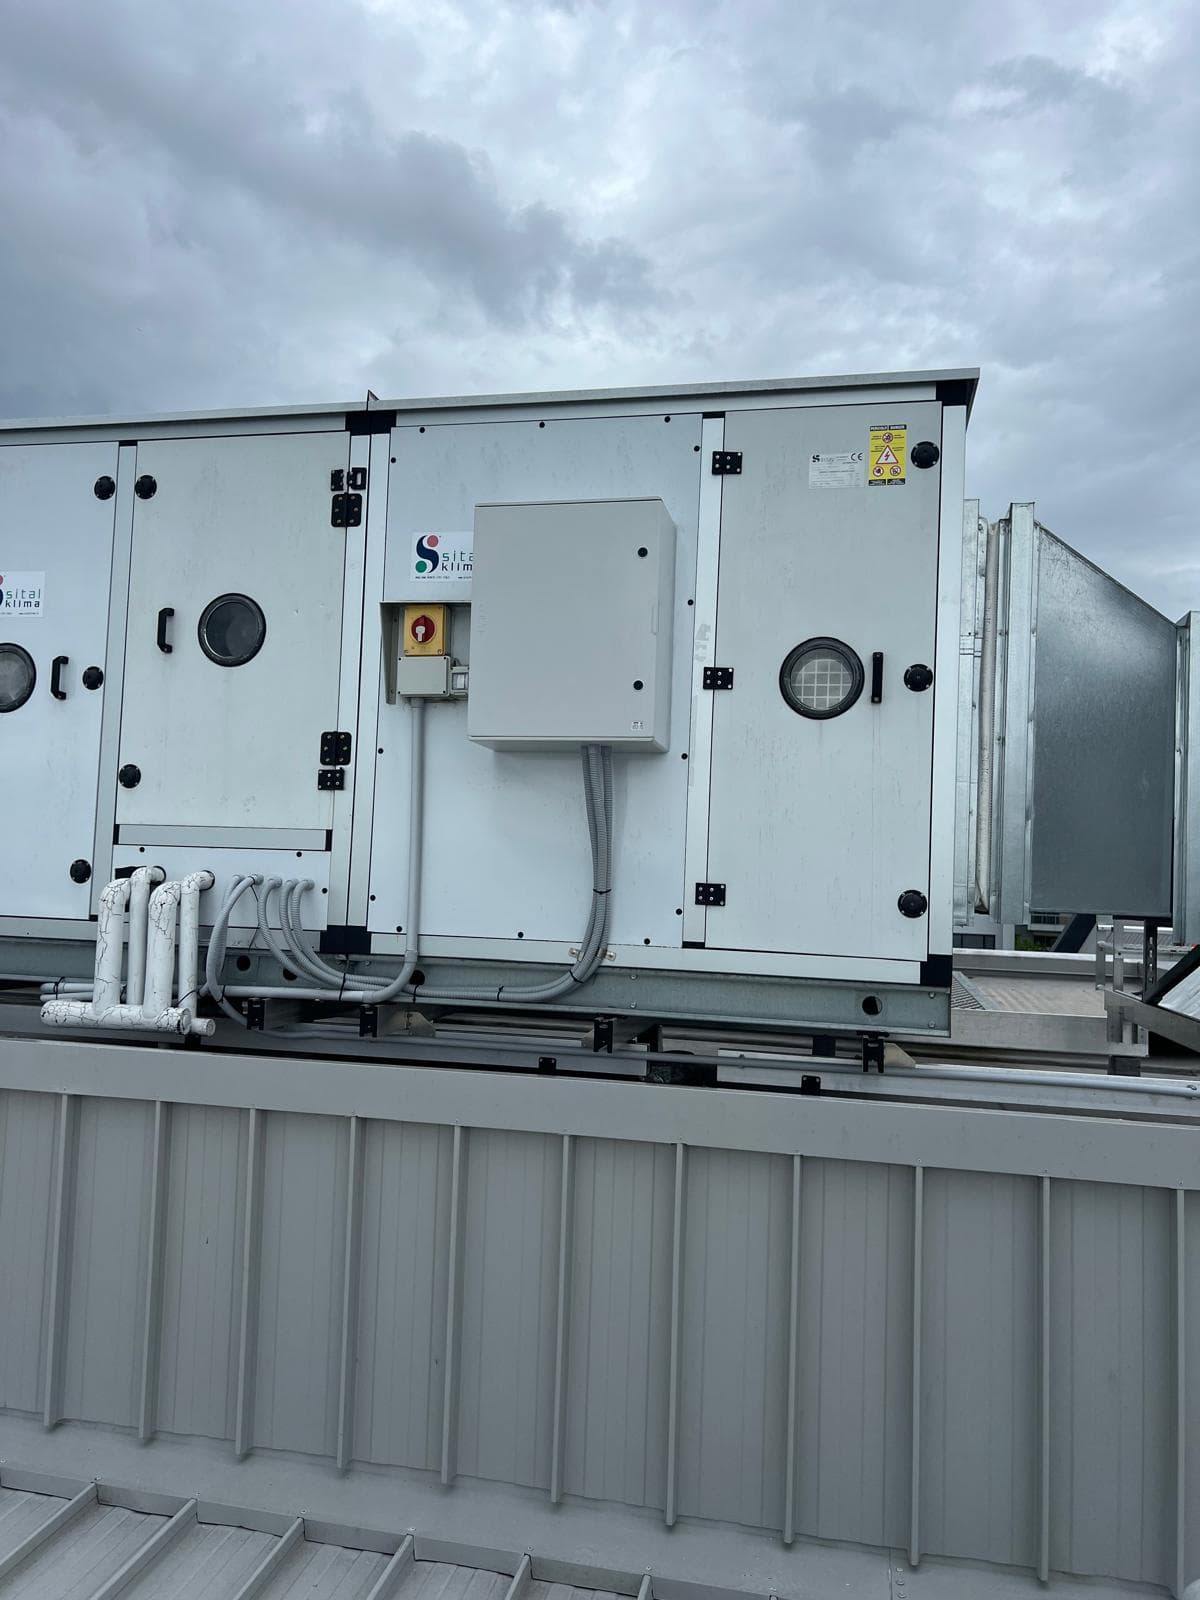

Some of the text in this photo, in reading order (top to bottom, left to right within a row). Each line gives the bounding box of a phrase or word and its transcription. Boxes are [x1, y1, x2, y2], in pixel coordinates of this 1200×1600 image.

[441, 562, 473, 571] klim
[6, 588, 41, 600] sital
[5, 599, 40, 608] klima
